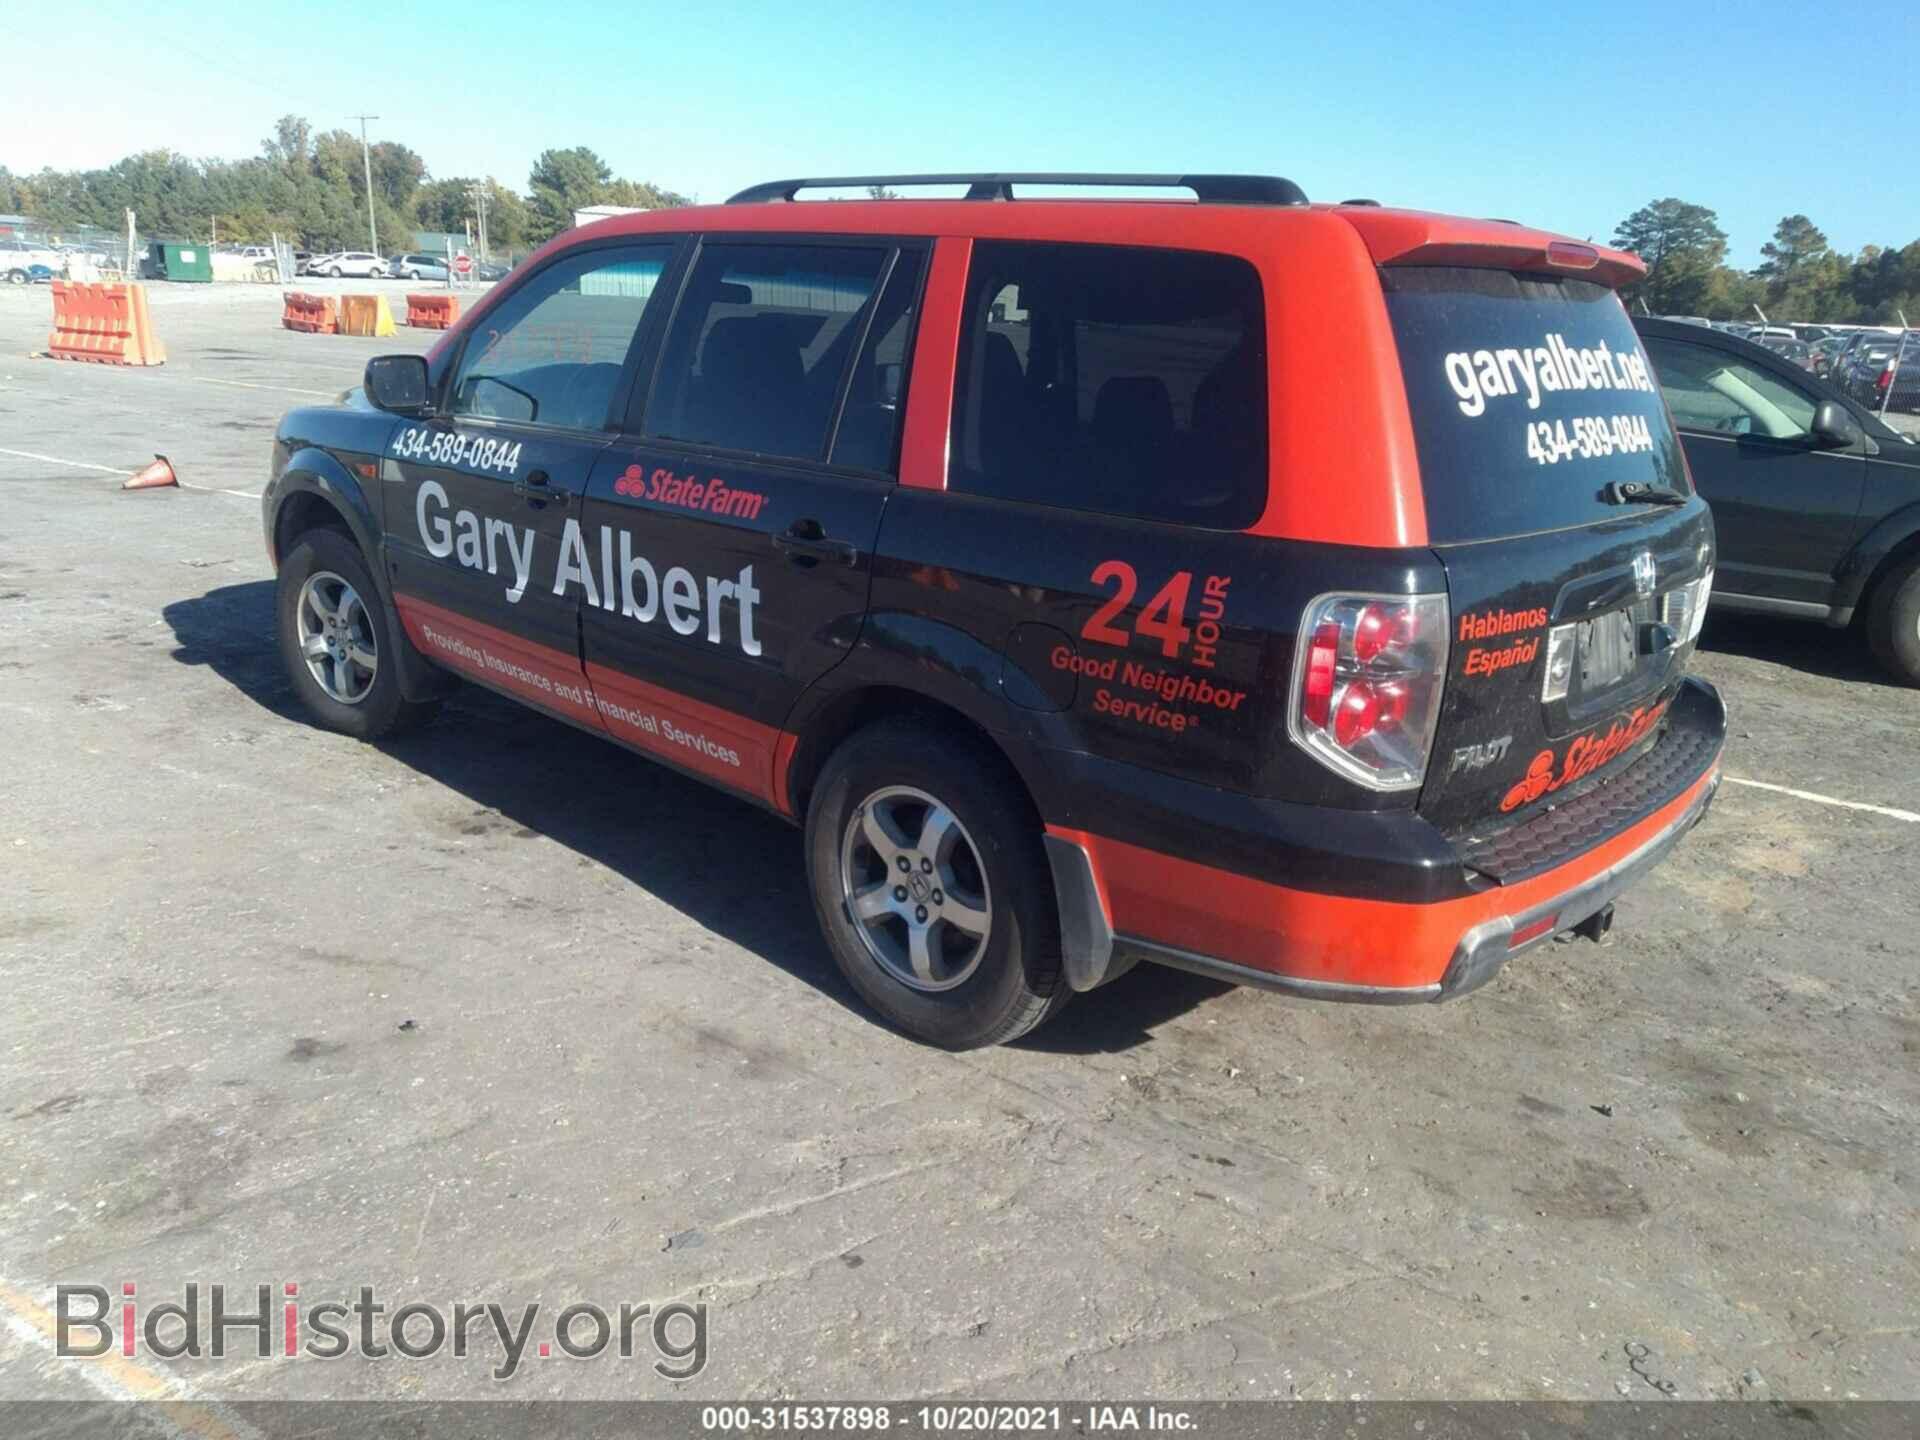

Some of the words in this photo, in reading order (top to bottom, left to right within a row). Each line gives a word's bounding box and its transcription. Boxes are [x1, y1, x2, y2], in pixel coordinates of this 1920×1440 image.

[1445, 333, 1655, 417] garyalbert.net
[392, 427, 523, 474] 434-589-0844
[1527, 415, 1654, 465] 434-589-0844
[416, 480, 536, 604] Gary
[552, 517, 763, 657] Albert
[1081, 559, 1193, 658] 24
[1192, 575, 1232, 669] HOUR
[1459, 607, 1547, 641] Hablamos
[1051, 646, 1118, 681] Good
[1121, 661, 1247, 711] Neighbor
[1464, 637, 1540, 677] Español
[423, 624, 485, 668] Providing
[484, 649, 551, 692] Insurance
[555, 682, 583, 706] and
[584, 689, 660, 735] Financial
[661, 719, 741, 768] Services
